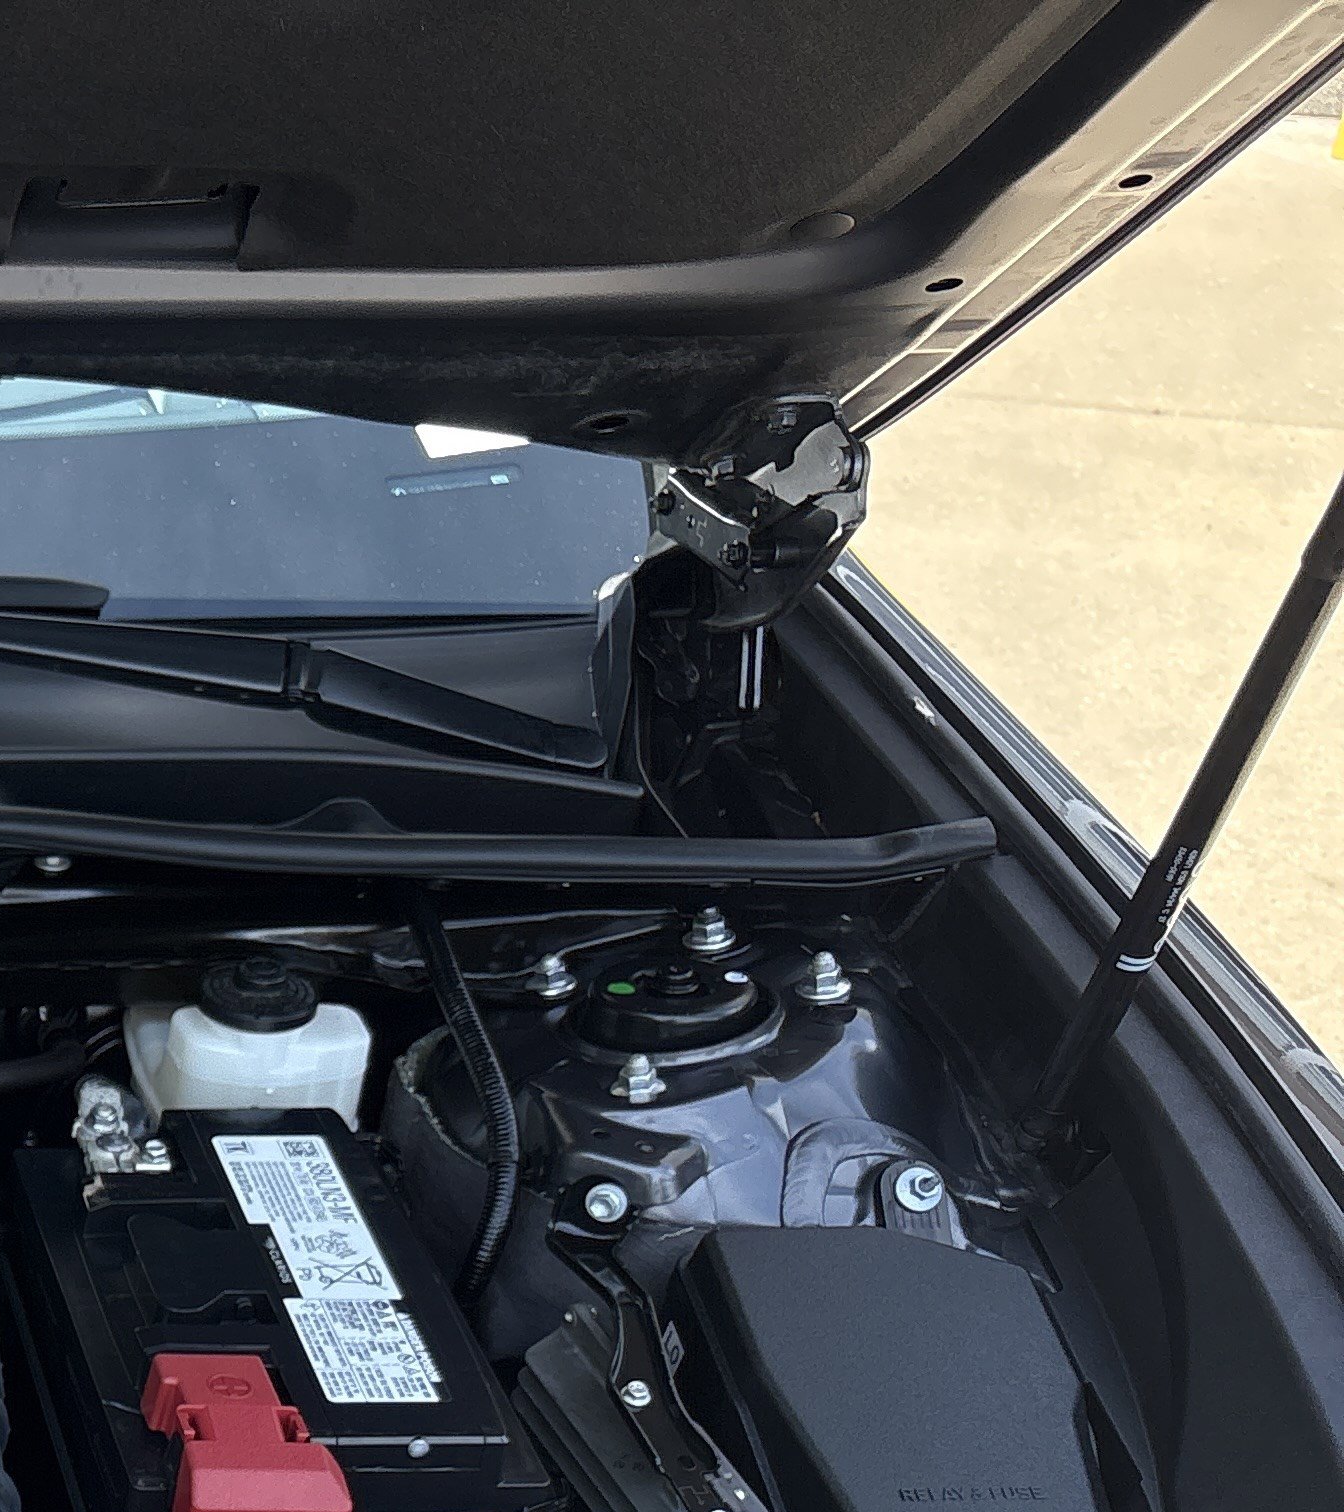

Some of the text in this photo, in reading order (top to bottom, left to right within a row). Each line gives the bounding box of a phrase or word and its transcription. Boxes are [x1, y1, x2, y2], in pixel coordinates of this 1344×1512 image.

[898, 1486, 1046, 1502] RELAY & FUSE
